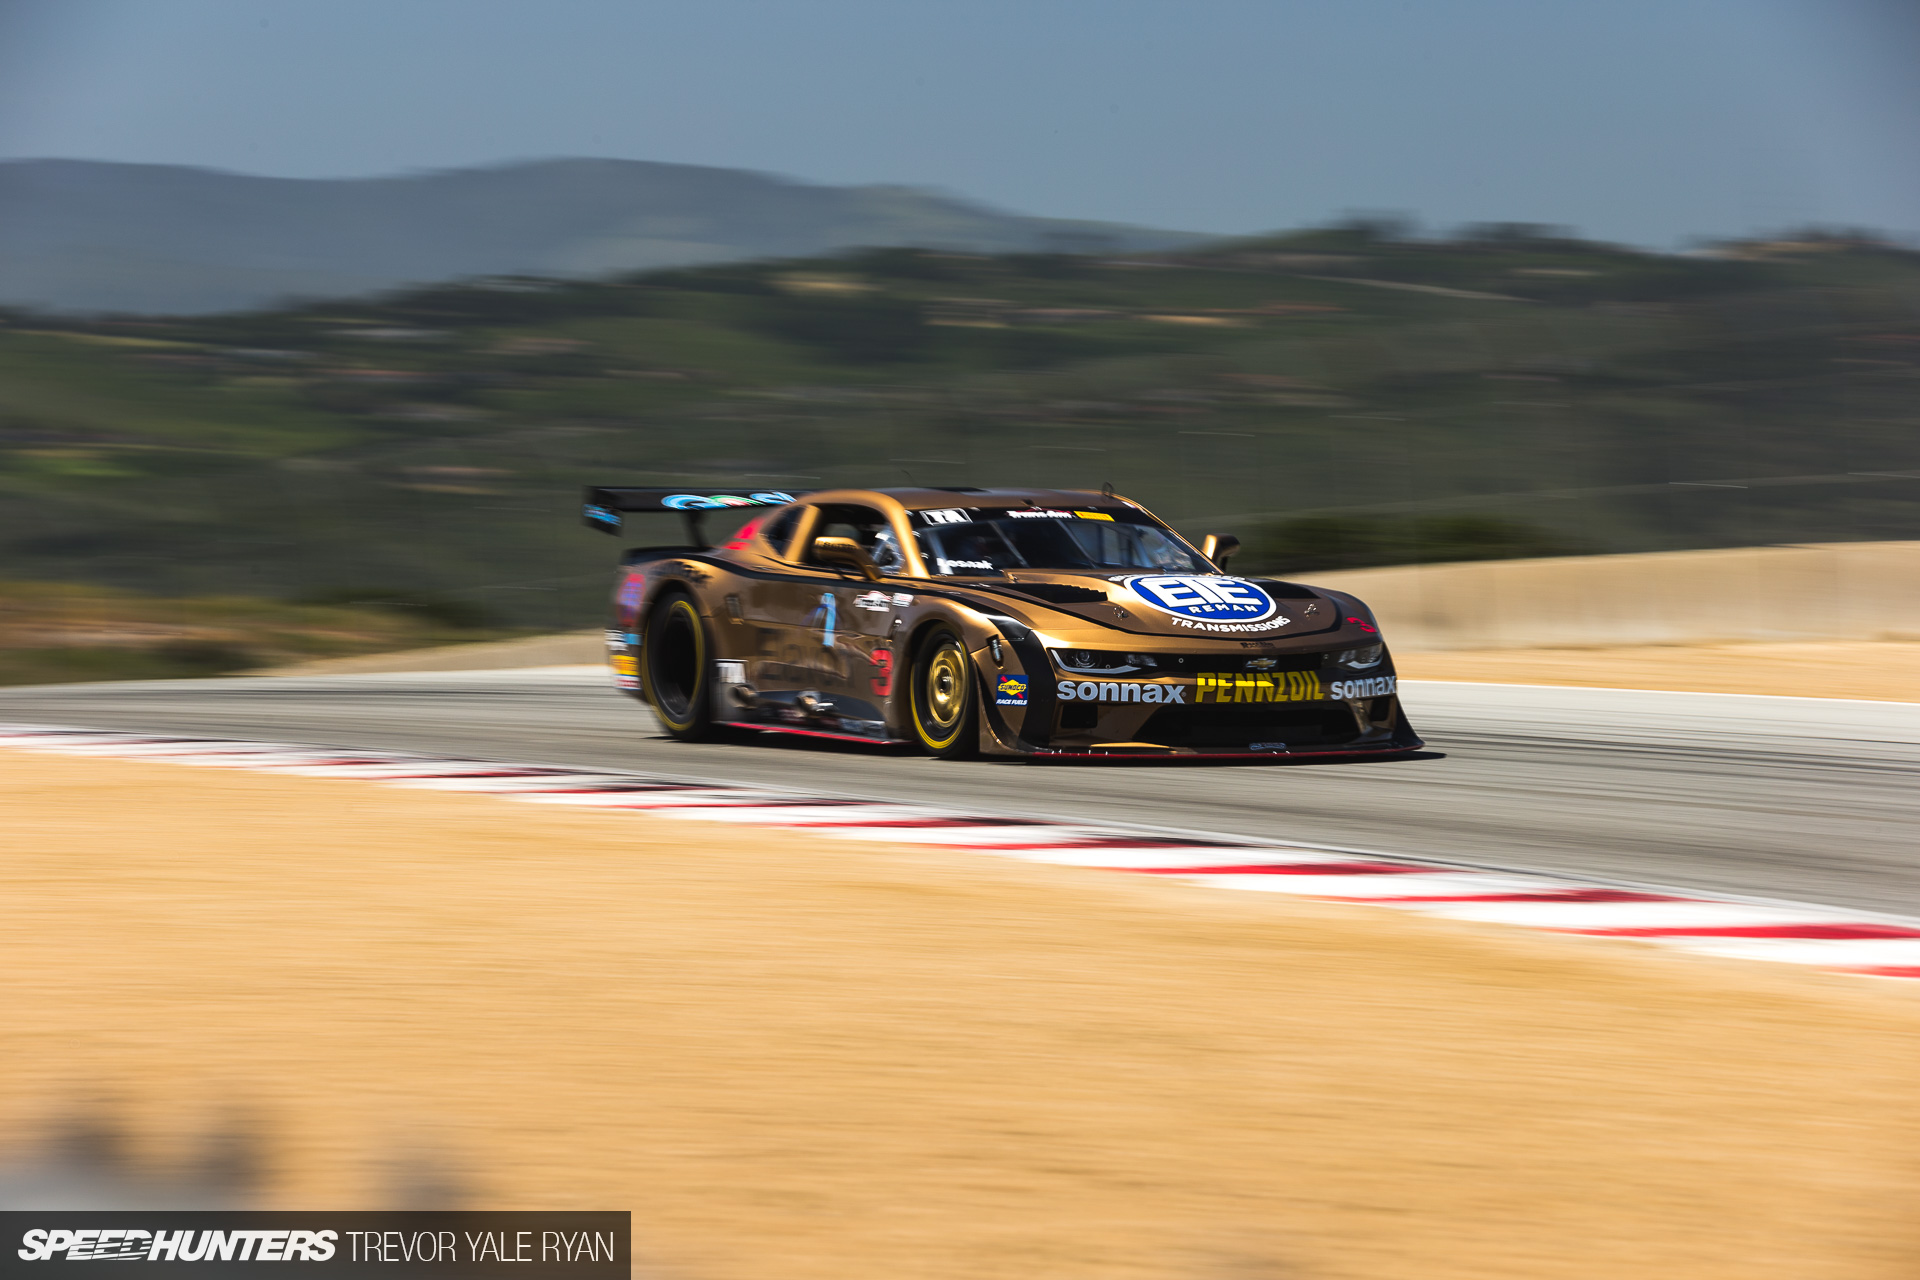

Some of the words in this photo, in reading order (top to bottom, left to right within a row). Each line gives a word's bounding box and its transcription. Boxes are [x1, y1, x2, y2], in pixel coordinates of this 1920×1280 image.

[1188, 603, 1259, 614] REMAN
[1171, 615, 1291, 633] TRANSMISSIONS
[1346, 616, 1378, 633] 3
[868, 649, 894, 697] 3
[1056, 680, 1186, 704] sonnax
[1194, 670, 1325, 703] PENNZOIL
[1330, 675, 1397, 700] sonnax
